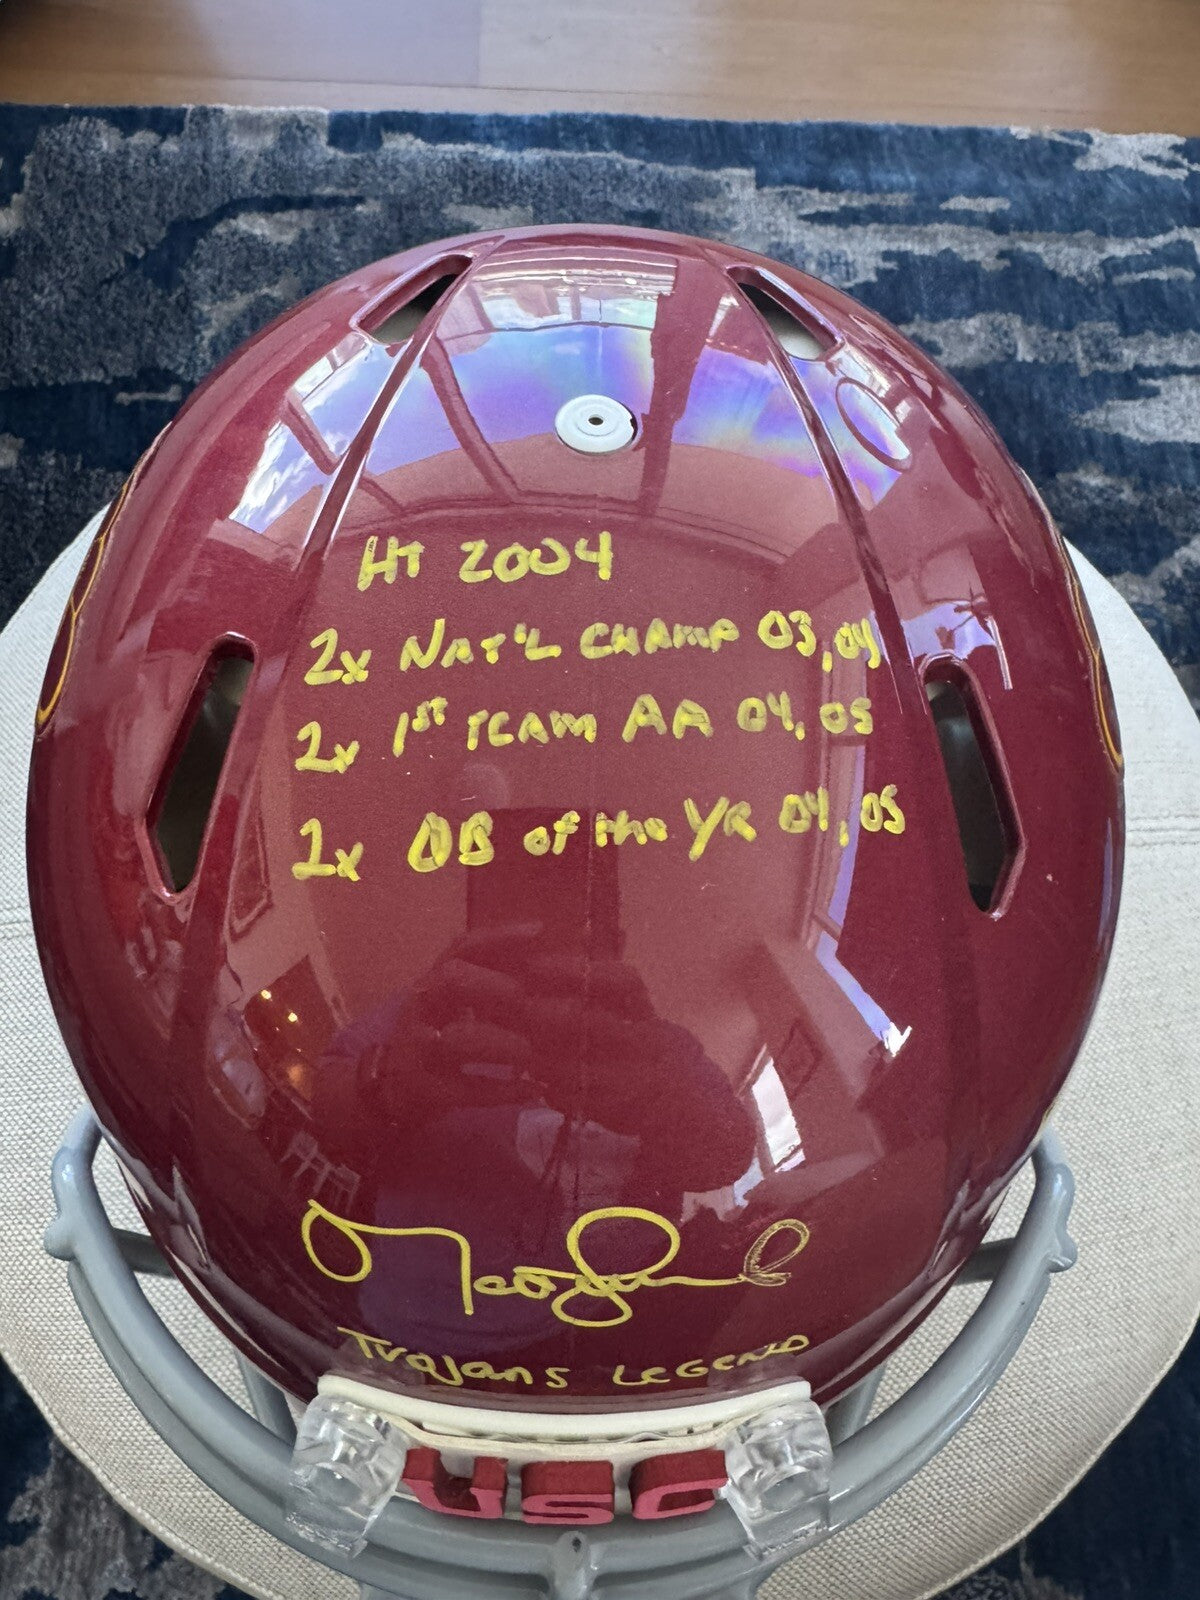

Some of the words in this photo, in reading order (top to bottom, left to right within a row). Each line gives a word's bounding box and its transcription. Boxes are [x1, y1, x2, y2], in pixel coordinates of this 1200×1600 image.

[459, 531, 613, 583] 2004
[819, 697, 873, 735] 05
[523, 810, 581, 856] of
[402, 1446, 728, 1526] USC
